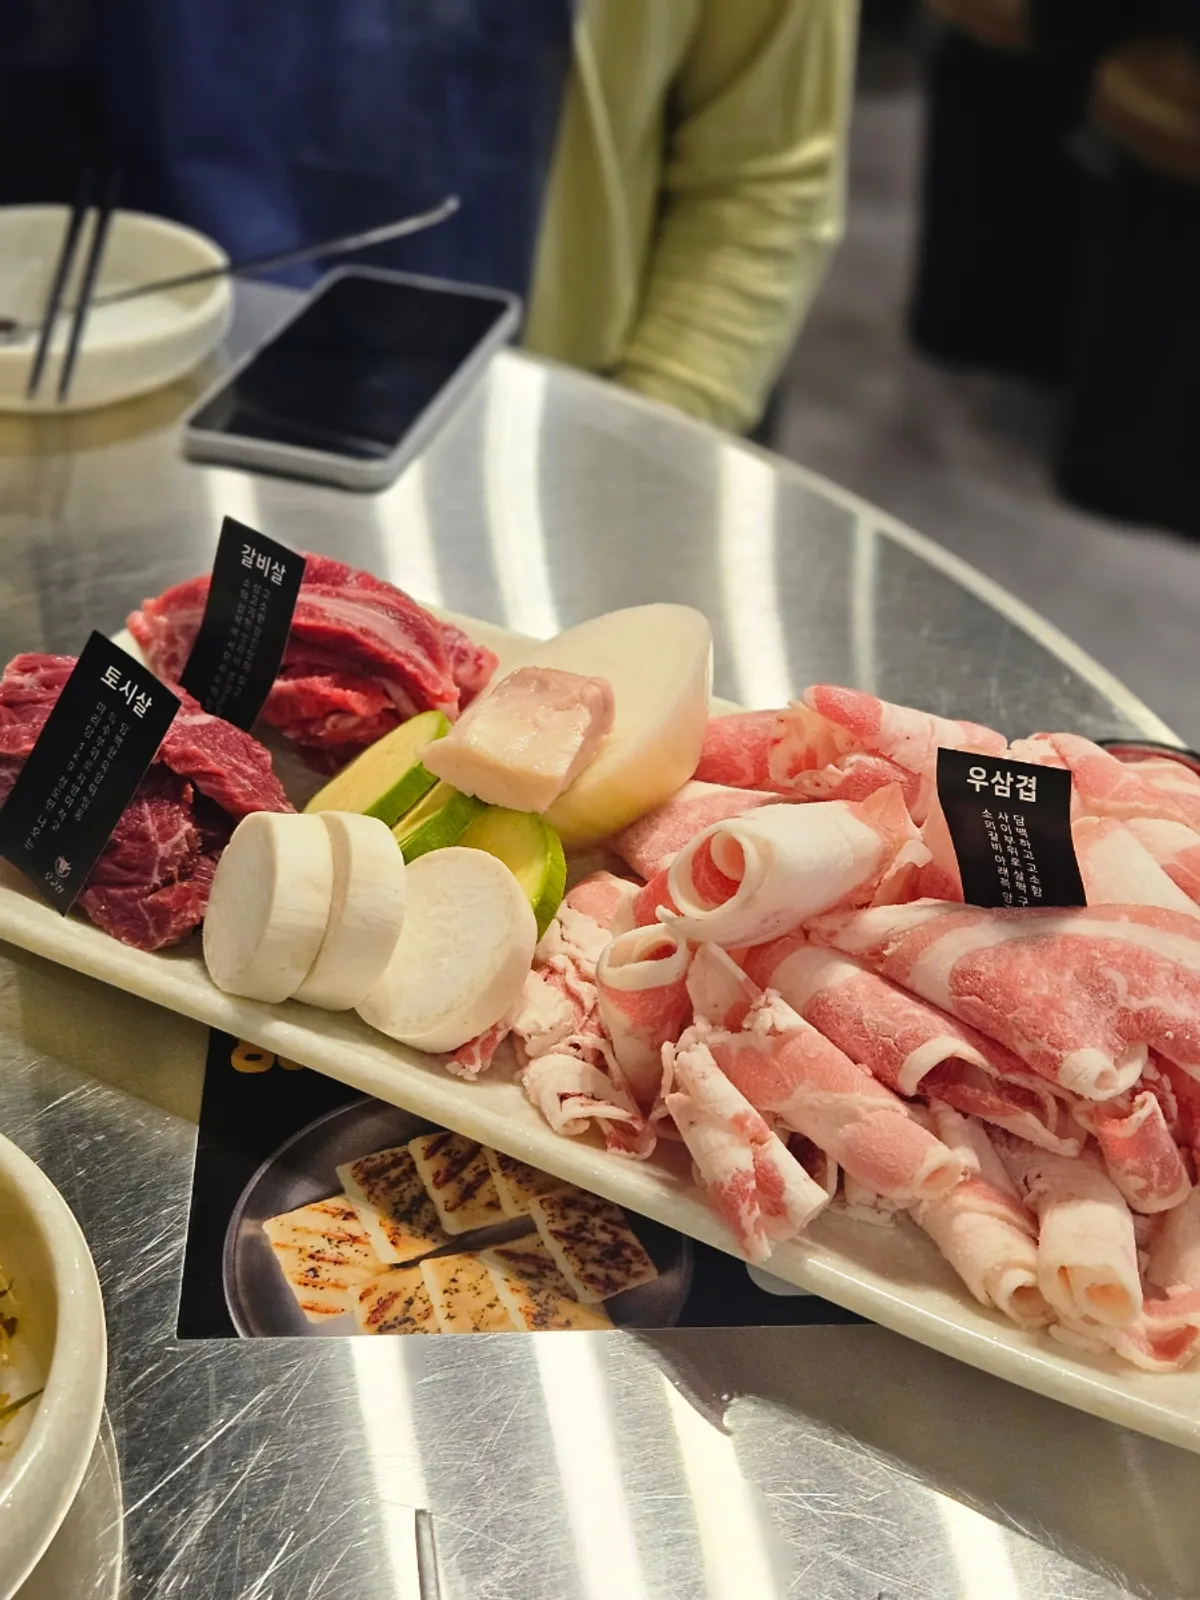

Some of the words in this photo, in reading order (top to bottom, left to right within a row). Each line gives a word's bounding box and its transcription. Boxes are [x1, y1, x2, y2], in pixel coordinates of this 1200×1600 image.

[242, 544, 286, 585] 갈비살
[100, 666, 152, 718] 토시살
[966, 766, 1037, 803] 우삼겹
